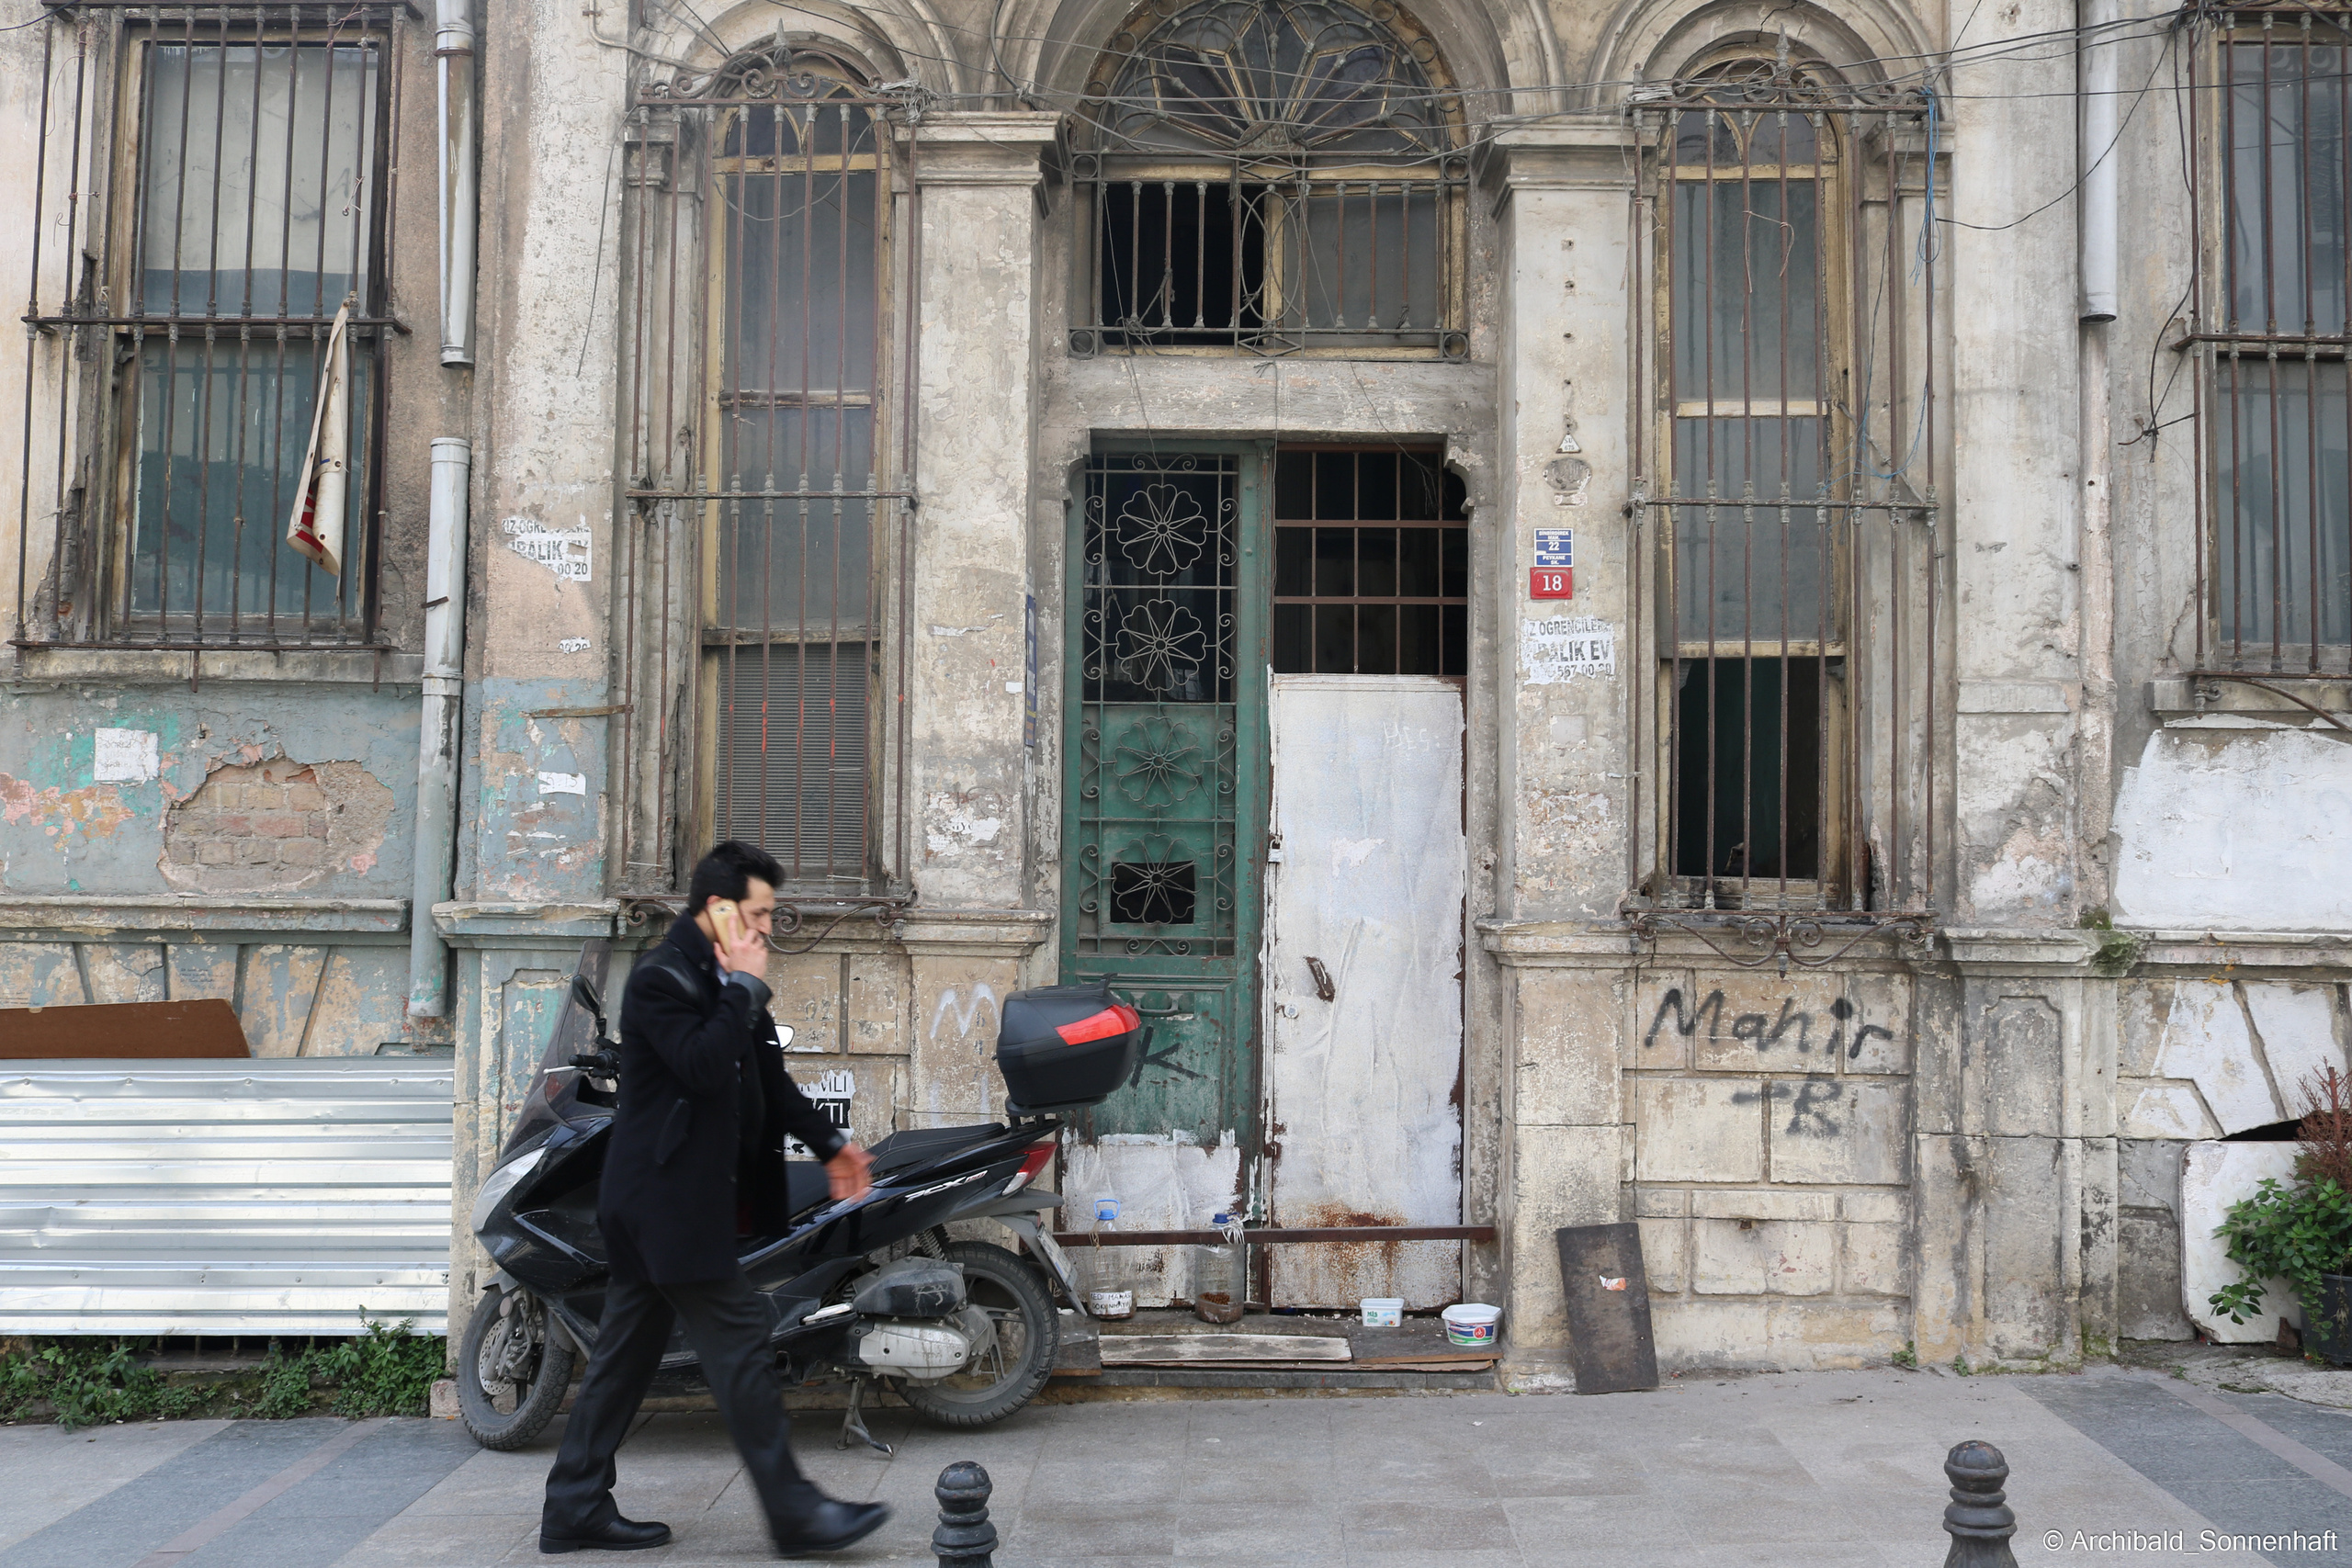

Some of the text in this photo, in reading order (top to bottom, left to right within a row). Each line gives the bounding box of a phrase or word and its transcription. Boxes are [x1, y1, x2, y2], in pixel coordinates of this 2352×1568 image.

[1548, 542, 1560, 551] 22
[574, 562, 588, 575] 20
[1543, 575, 1562, 592] 18
[1589, 639, 1611, 661] EV
